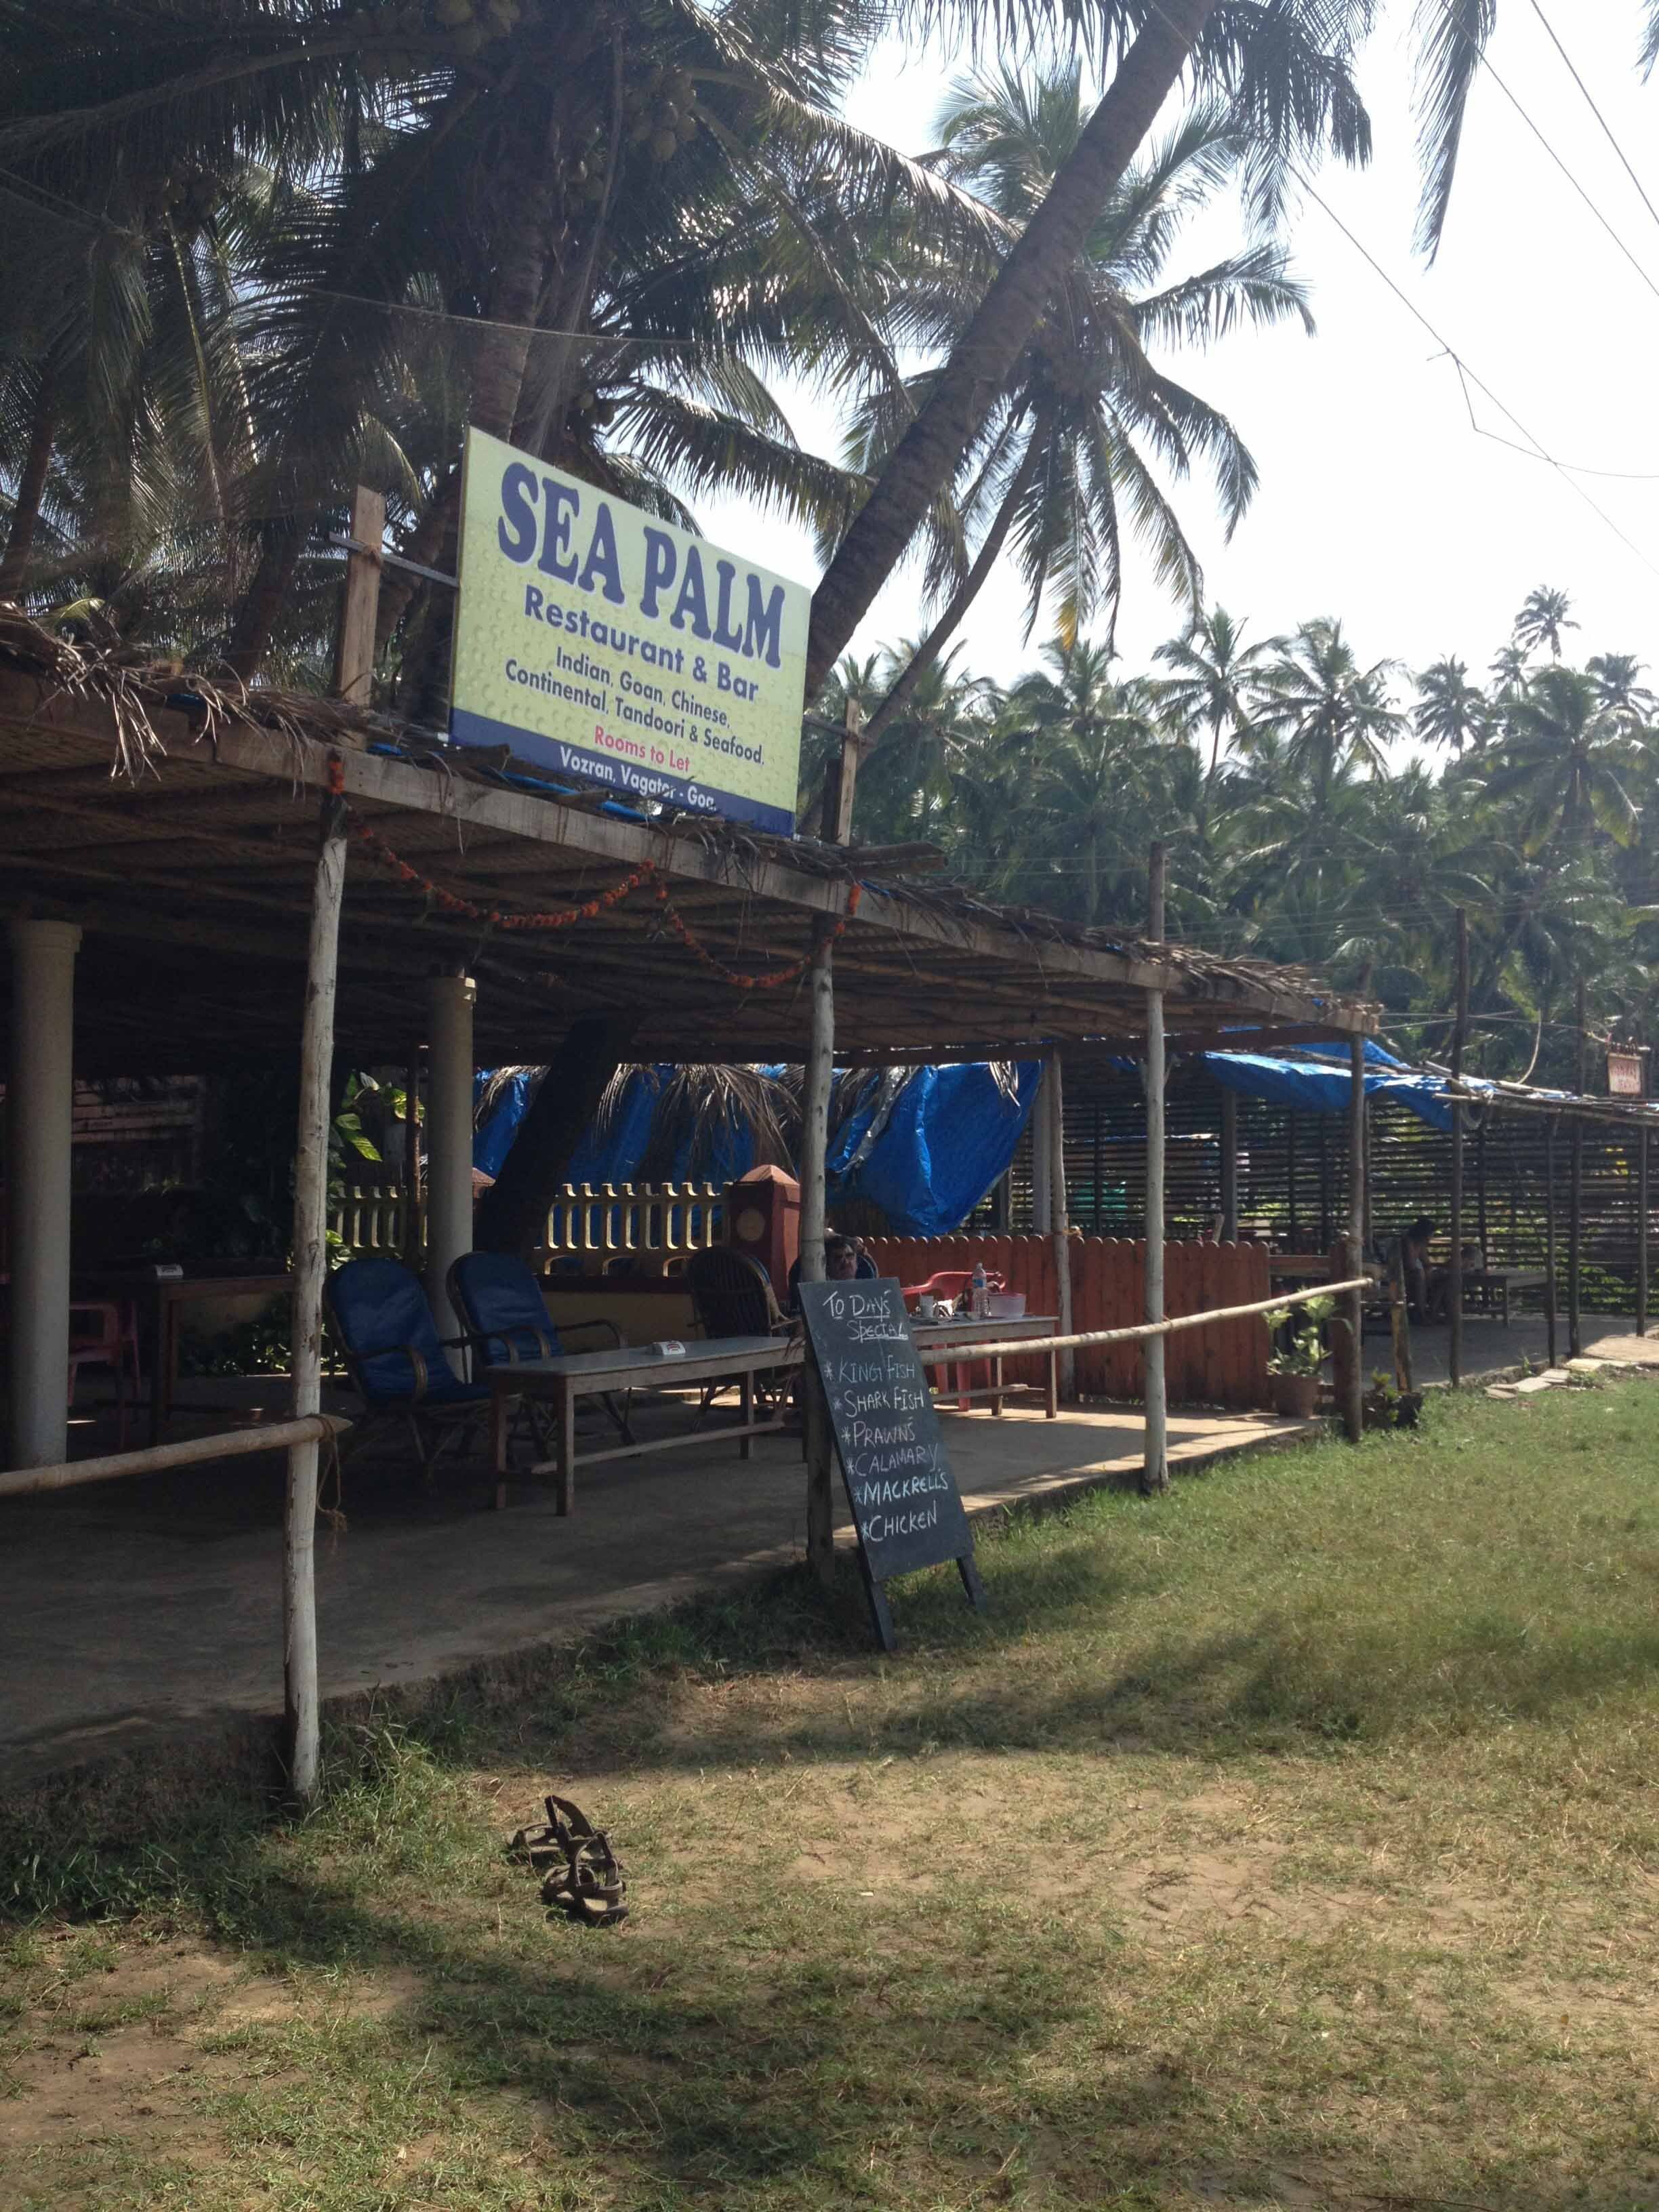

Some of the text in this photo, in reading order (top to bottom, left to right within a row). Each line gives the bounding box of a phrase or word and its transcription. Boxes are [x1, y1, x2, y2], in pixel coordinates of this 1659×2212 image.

[498, 462, 785, 668] SEA PALM
[525, 585, 758, 701] Restaurant & Bar
[556, 647, 730, 729] Indian, Goan, Chinese,
[506, 659, 764, 765] Continental, Tandoori & Seafood.
[560, 746, 615, 782] Vozran,
[621, 764, 676, 796] Vagator
[594, 726, 690, 771] Rooms to Let
[840, 1355, 915, 1382] KING FISH
[844, 1386, 924, 1418] SHARK FISH
[855, 1443, 938, 1476] CALAMARY
[869, 1499, 937, 1542] CHICKEN
